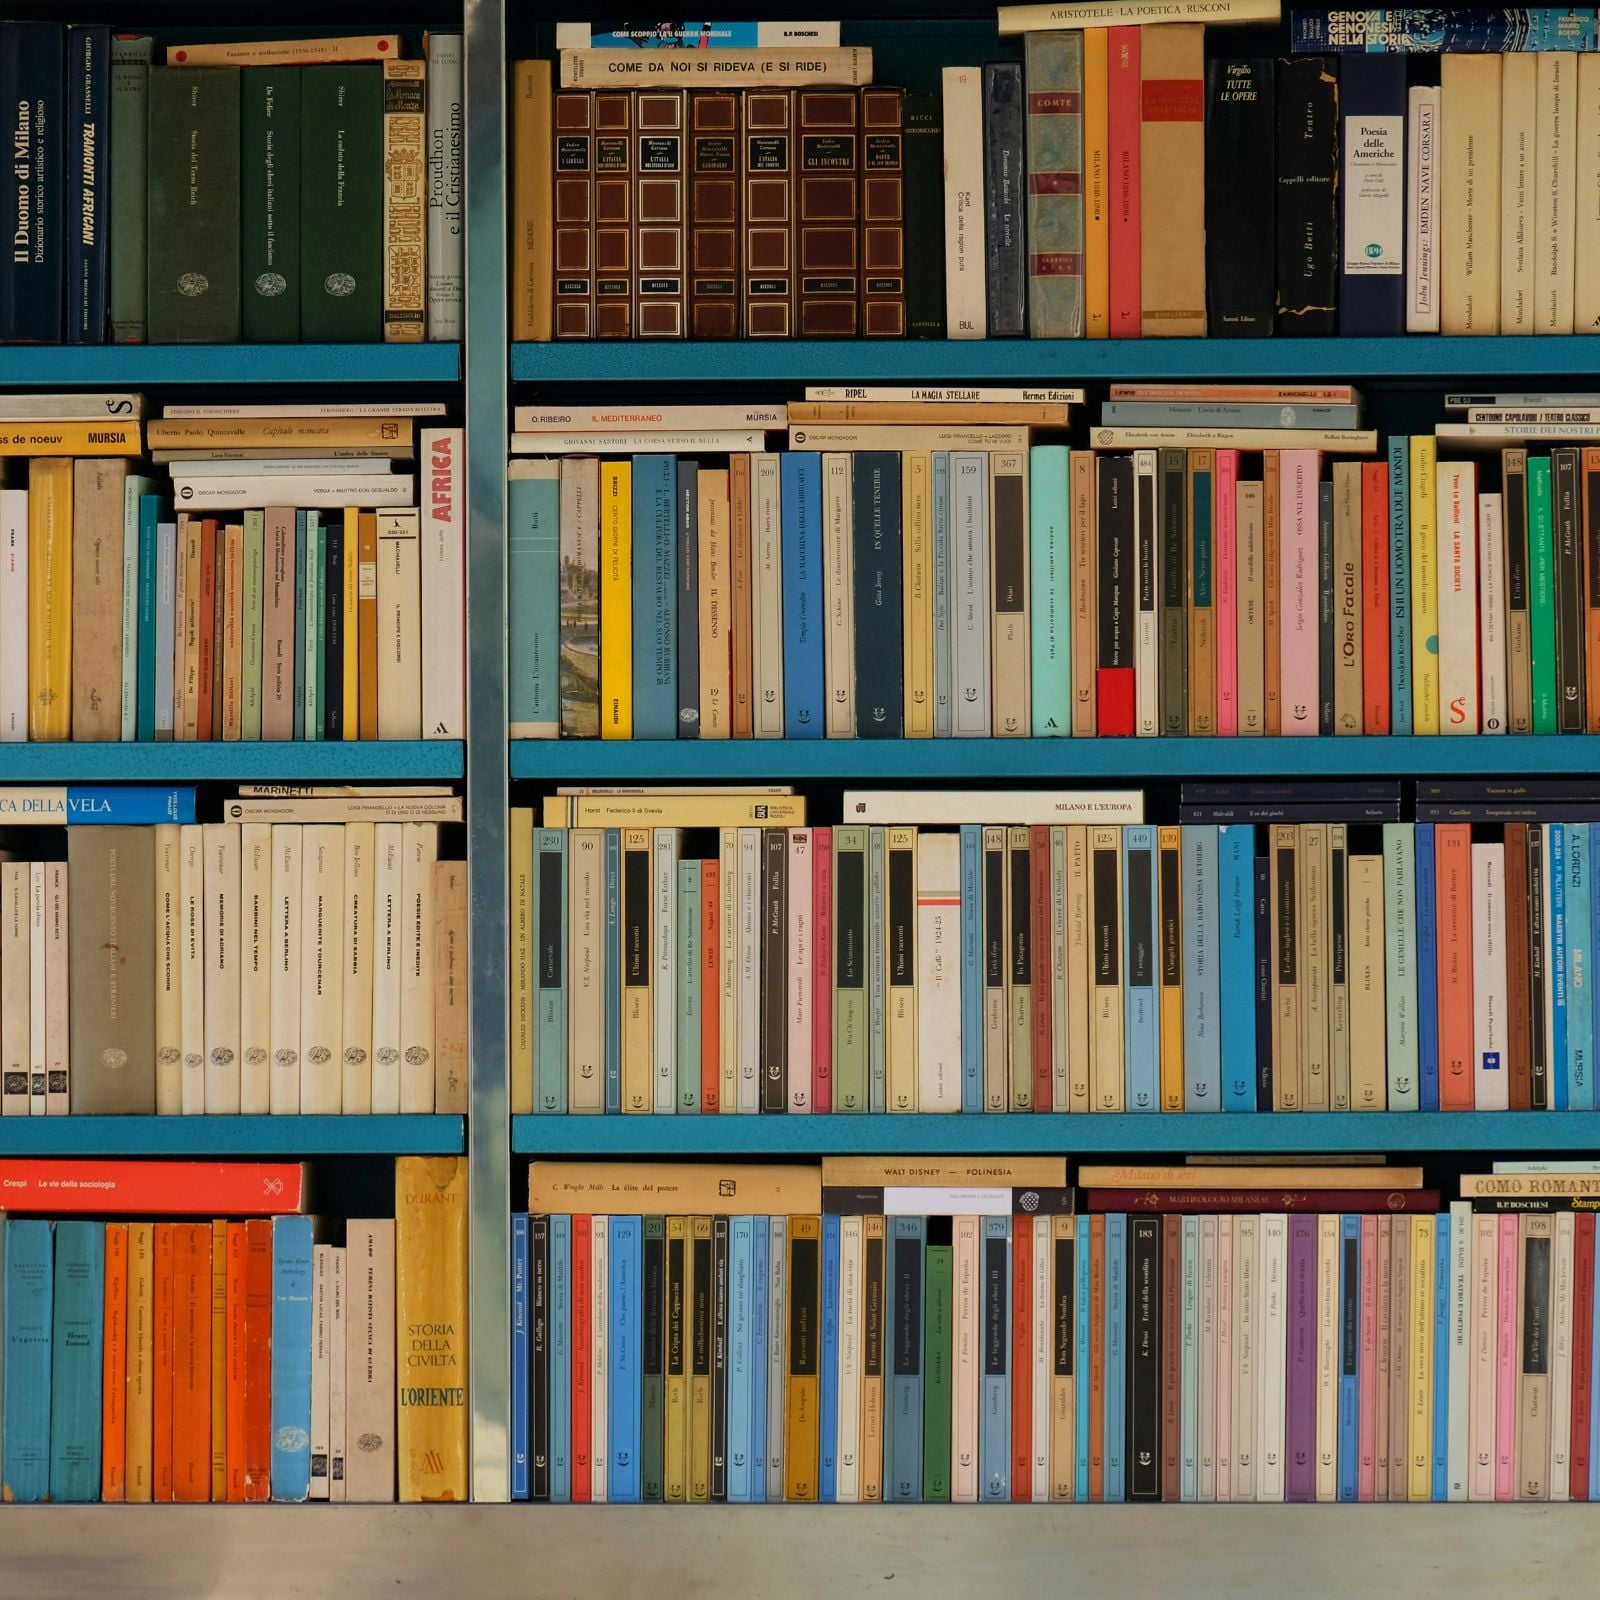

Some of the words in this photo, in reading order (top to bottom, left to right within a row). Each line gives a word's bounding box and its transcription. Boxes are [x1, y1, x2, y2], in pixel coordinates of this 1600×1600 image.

[1050, 8, 1113, 19] ARISTOTELE
[1120, 7, 1134, 16] LA
[1137, 5, 1181, 15] POETICA
[1187, 3, 1230, 13] RUSCONI
[1328, 11, 1380, 22] GENOVA
[1385, 11, 1392, 22] E
[1328, 34, 1364, 45] NELLA
[1366, 34, 1411, 45] STORIA
[608, 62, 643, 73] COME
[648, 62, 664, 73] DA
[671, 62, 691, 73] NOI
[697, 62, 708, 73] SI
[714, 62, 755, 73] RIDEVA
[761, 61, 773, 73] (E
[779, 61, 790, 72] SI
[795, 60, 827, 73] RIDE)
[1226, 79, 1252, 89] TUTTE
[1037, 99, 1072, 107] COMTE
[1220, 91, 1231, 101] LE
[1231, 91, 1258, 101] OPERE
[35, 100, 46, 136] religioso
[14, 101, 30, 159] Milano
[1361, 127, 1388, 137] Poesia
[1420, 111, 1432, 162] CORSARA
[1363, 139, 1384, 149] delle
[83, 122, 95, 184] TRAMONTI
[446, 102, 461, 207] Cristianesimo
[1353, 150, 1394, 159] Americhe
[14, 164, 30, 180] di
[35, 146, 45, 182] artistico
[430, 128, 444, 209] Proudhon
[1420, 165, 1432, 194] NAVE
[35, 184, 45, 214] storico
[14, 184, 30, 245] Duomo
[82, 187, 95, 245] AFRICANI
[446, 212, 461, 220] il
[1420, 197, 1432, 235] EMDEN
[450, 226, 461, 235] e
[1304, 221, 1313, 250] Betti
[35, 217, 45, 263] Dizionario
[14, 250, 30, 263] Il
[1420, 239, 1430, 280] Jennings:
[1304, 256, 1314, 278] Ugo
[1420, 285, 1428, 307] John
[959, 321, 974, 330] BUL
[845, 389, 867, 399] RIPEL
[911, 390, 920, 400] LA
[921, 390, 943, 400] MAGIA
[946, 390, 980, 400] STELLARE
[1022, 391, 1046, 400] Hermes
[1048, 391, 1074, 400] Edizioni
[207, 428, 246, 437] Quintavalle
[262, 426, 294, 437] Capitale
[1504, 427, 1536, 435] STORIE
[1540, 427, 1554, 435] DEI
[1556, 427, 1594, 435] NOSTRI
[961, 466, 976, 474] 159
[1393, 447, 1404, 486] MONDI
[431, 437, 452, 523] AFRICA
[873, 467, 881, 505] TENEBRE
[1394, 489, 1404, 513] DUE
[873, 507, 881, 539] QUELLE
[1395, 514, 1405, 537] TRA
[1454, 531, 1461, 540] LA
[873, 540, 881, 550] IN
[1395, 539, 1405, 575] UOMO
[1395, 578, 1405, 595] UN
[1454, 565, 1462, 593] SOCIETÀ
[1343, 562, 1354, 617] Fatale
[1396, 597, 1406, 618] ISHI
[23, 798, 65, 812] DELLA
[69, 798, 111, 812] VELA
[1572, 834, 1580, 844] A.
[1074, 869, 1081, 878] IL
[1572, 844, 1580, 888] LORENZI
[190, 896, 195, 906] LE
[190, 928, 195, 937] DI
[219, 928, 224, 936] DI
[632, 925, 640, 952] racconti
[632, 953, 640, 976] Ultimi
[1573, 948, 1582, 988] MILANO
[1575, 1049, 1583, 1088] MURSIA
[884, 1168, 907, 1176] WALT
[909, 1168, 940, 1176] DISNEY
[966, 1168, 1012, 1176] POLINESIA
[3, 1179, 27, 1188] Crespi
[47, 1179, 56, 1188] vie
[60, 1179, 77, 1188] della
[78, 1180, 115, 1190] sociologia
[611, 1184, 620, 1192] La
[642, 1184, 653, 1192] del
[657, 1185, 679, 1193] potere
[1476, 1180, 1522, 1194] COMO
[405, 1193, 457, 1205] DURANT
[1530, 1220, 1547, 1230] 198
[1138, 1230, 1153, 1238] 183
[408, 1324, 455, 1337] STORIA
[412, 1339, 451, 1351] DELLA
[401, 1388, 464, 1407] L'ORIENTE
